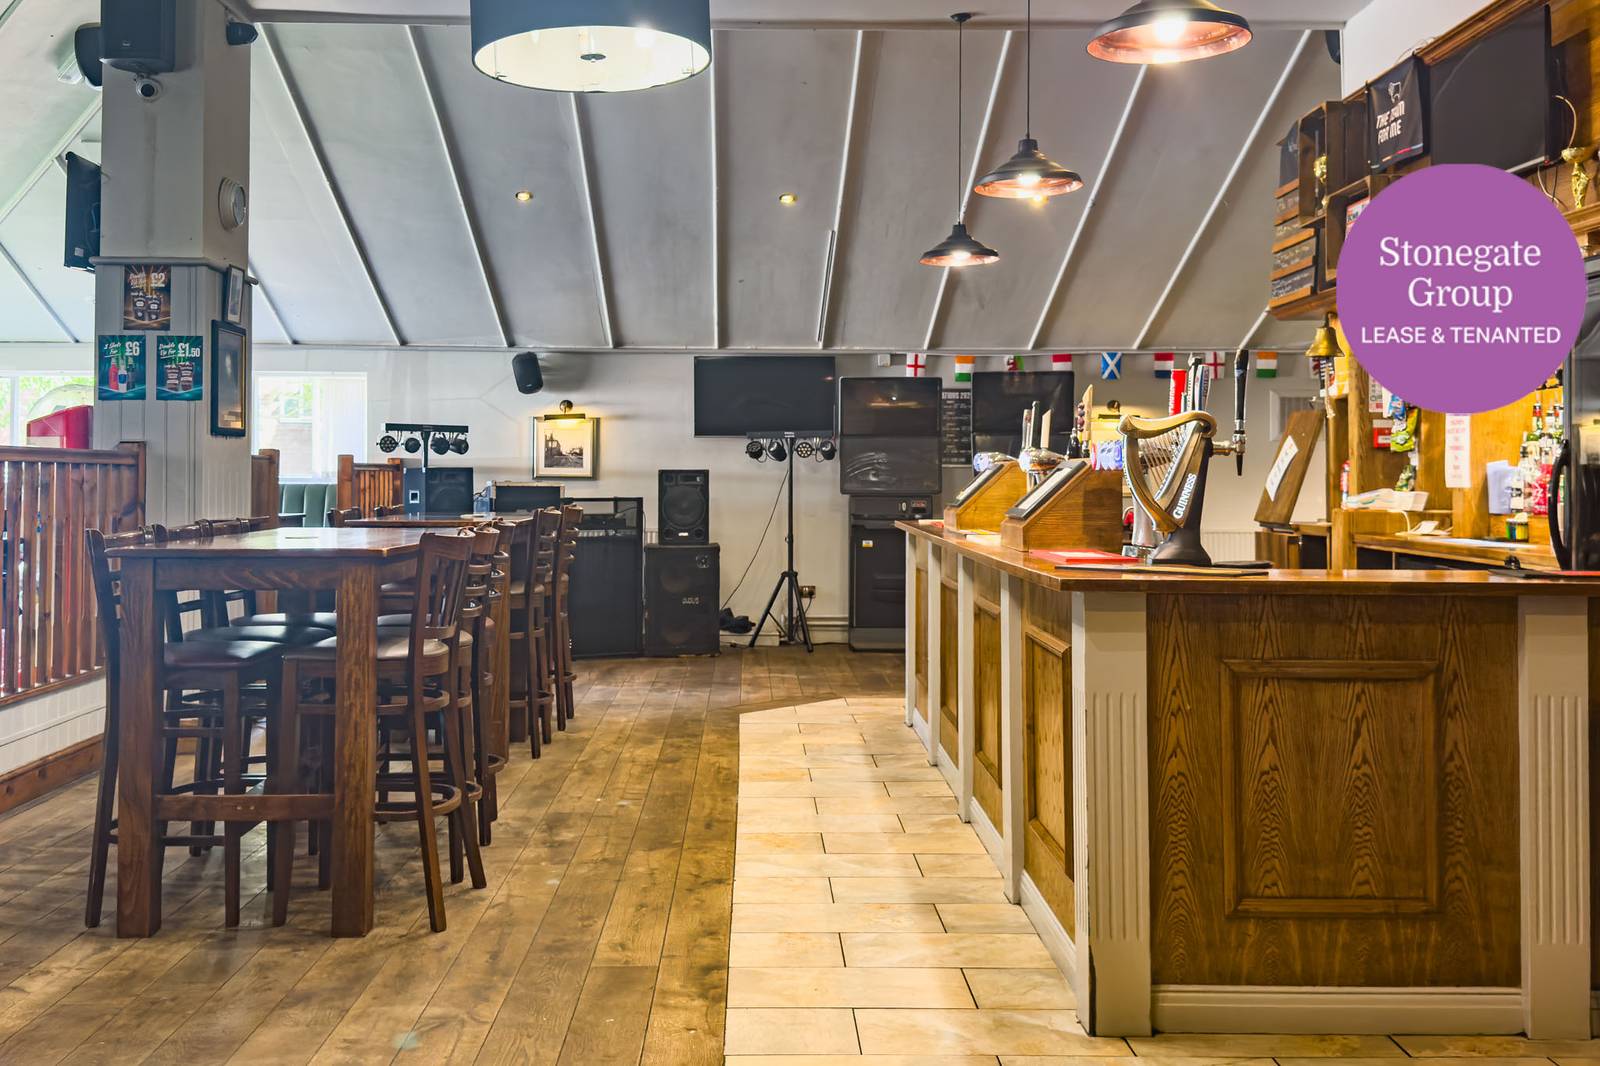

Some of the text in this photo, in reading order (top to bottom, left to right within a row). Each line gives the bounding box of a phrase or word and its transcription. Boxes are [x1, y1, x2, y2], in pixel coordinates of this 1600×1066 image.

[1378, 119, 1402, 145] FOR ME
[1172, 473, 1197, 519] GUINNESS
